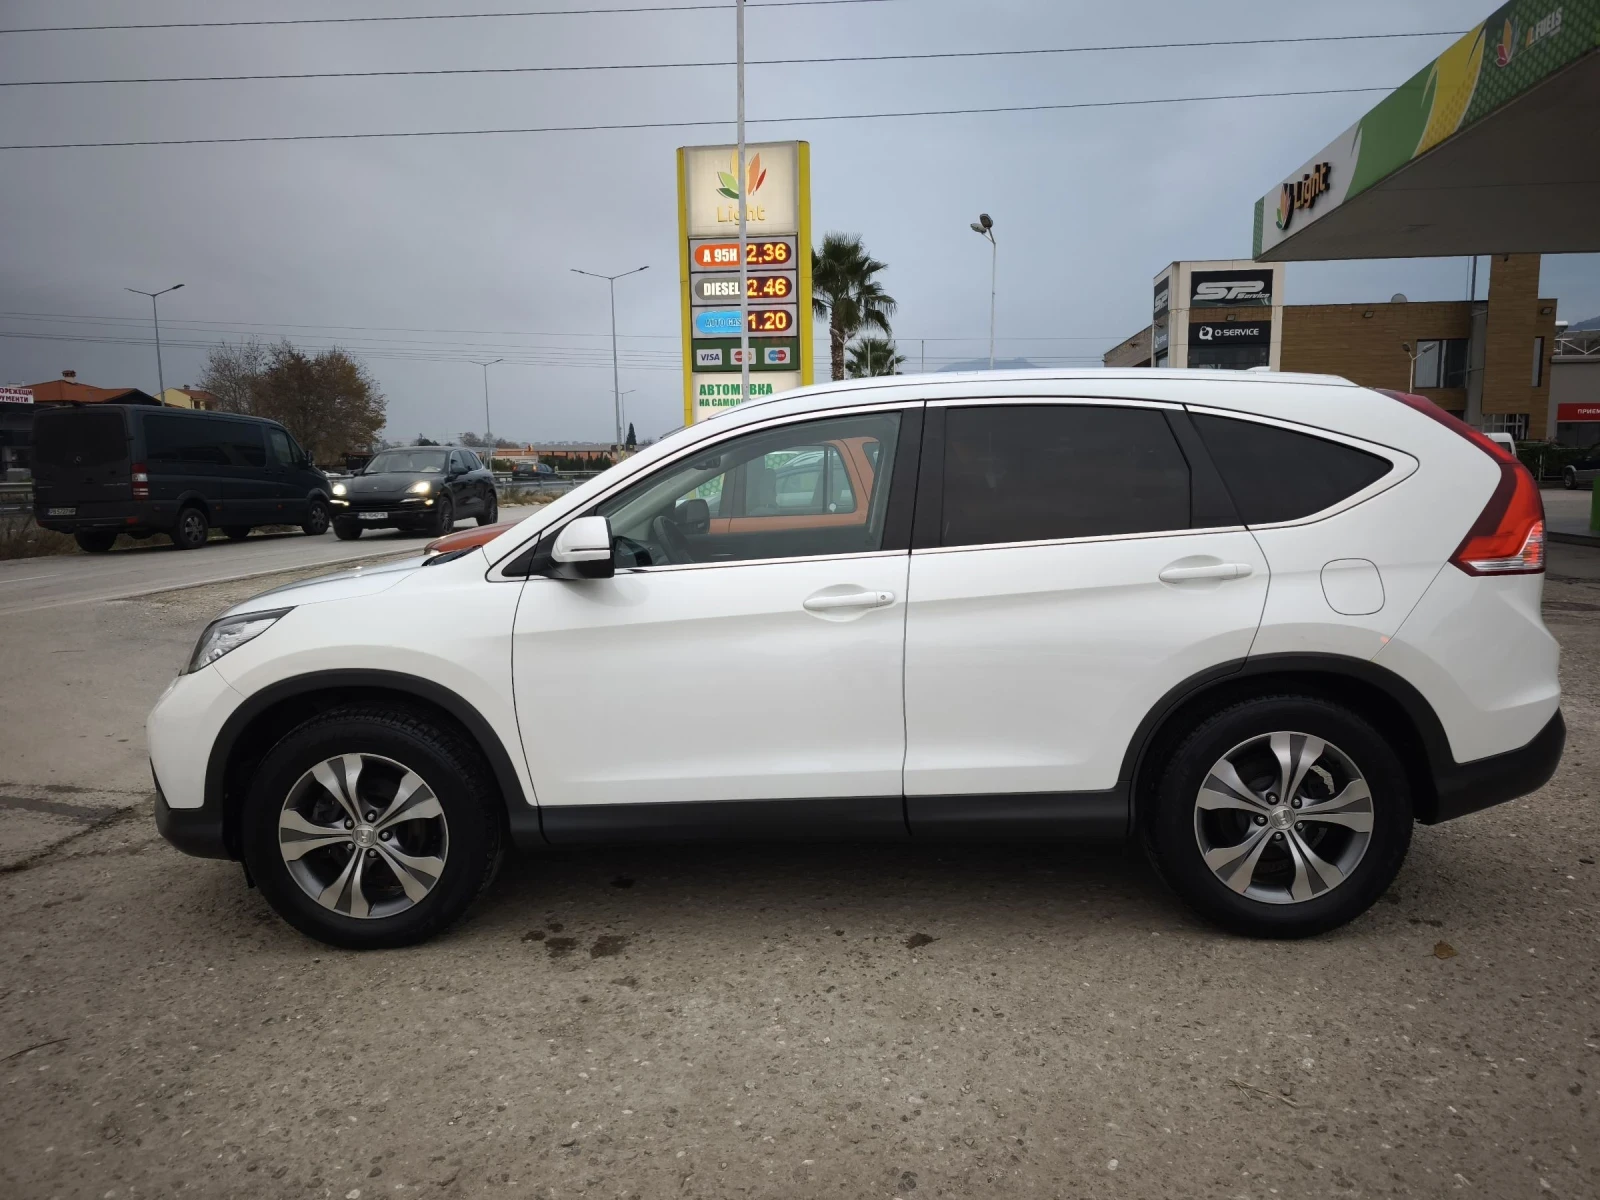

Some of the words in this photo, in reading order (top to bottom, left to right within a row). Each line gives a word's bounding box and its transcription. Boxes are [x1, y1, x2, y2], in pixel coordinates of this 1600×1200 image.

[1294, 162, 1331, 209] Light
[703, 250, 711, 262] A
[714, 248, 737, 262] 95H
[703, 282, 740, 296] DIESEL
[747, 278, 786, 296] 2.46
[1193, 280, 1264, 300] SP
[704, 318, 725, 328] AUTO
[747, 312, 787, 329] 1.20
[700, 353, 720, 361] VISA
[699, 383, 773, 396] АВТОМВКА
[699, 398, 710, 407] НА
